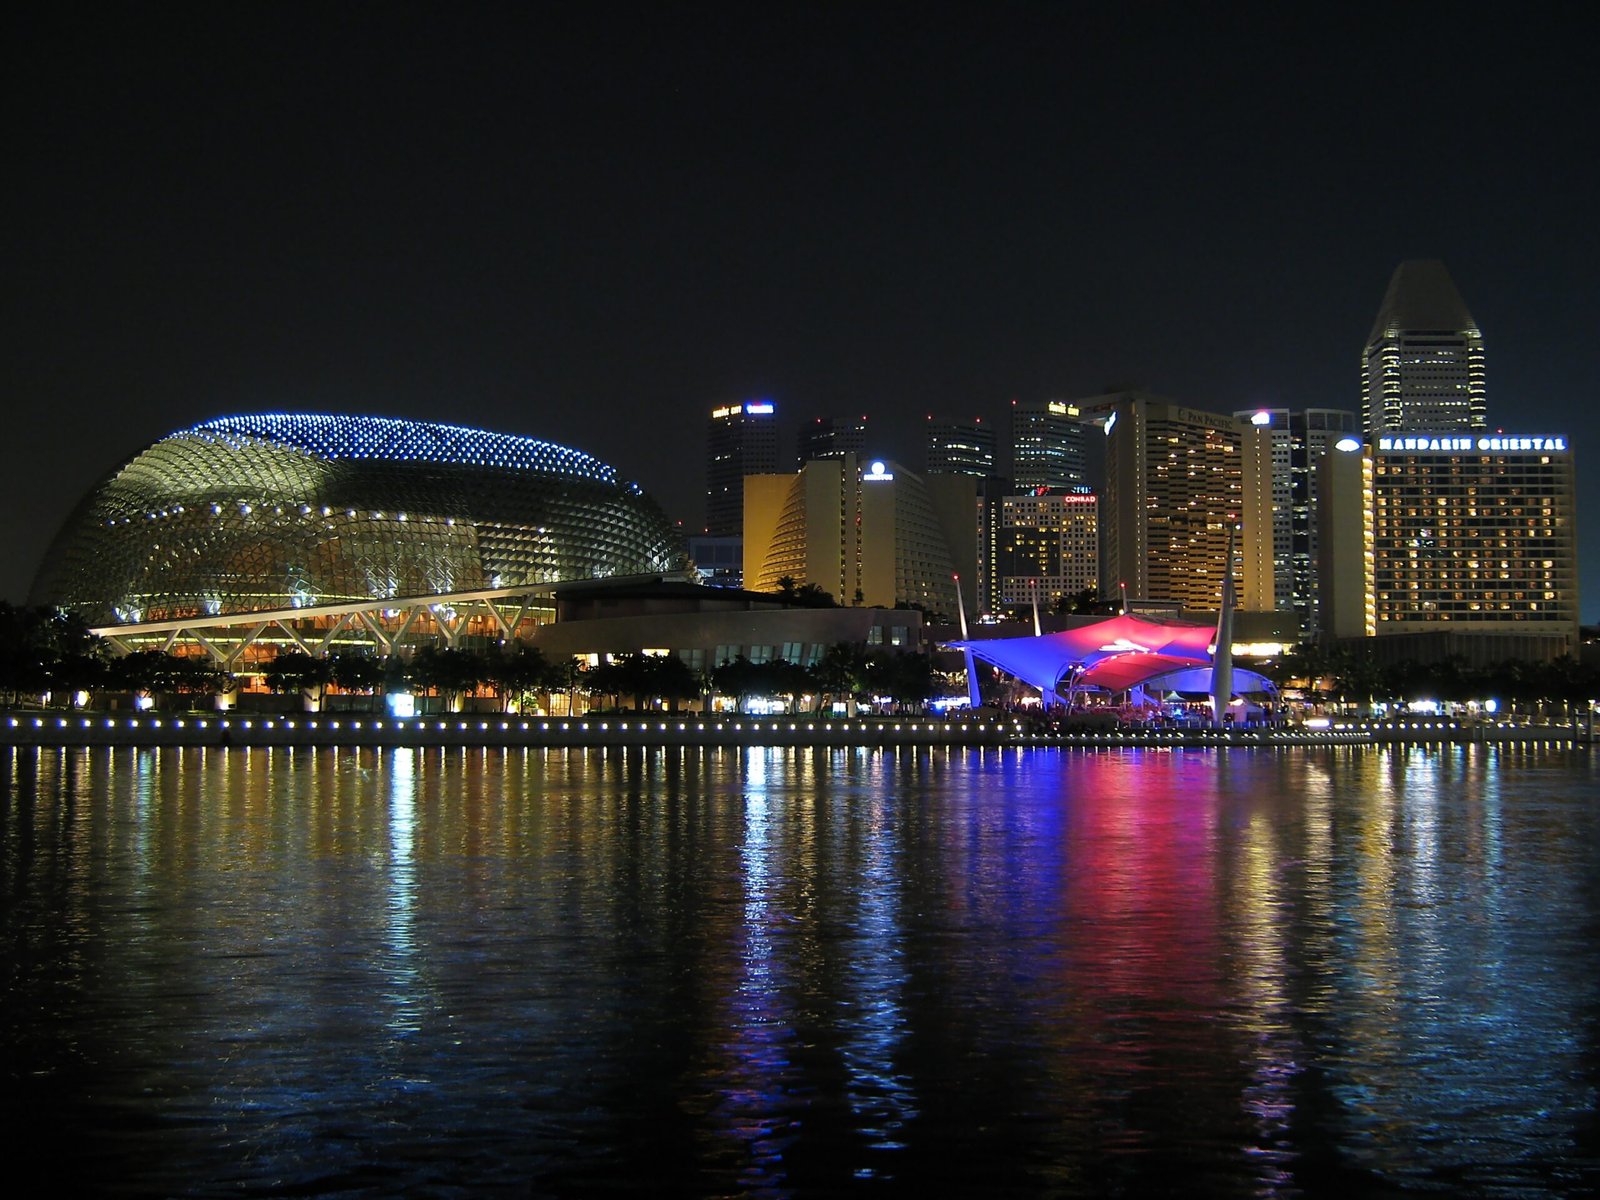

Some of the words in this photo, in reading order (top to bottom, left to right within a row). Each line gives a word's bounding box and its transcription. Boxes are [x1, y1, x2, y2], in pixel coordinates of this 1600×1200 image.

[1188, 411, 1204, 425] PAN
[1204, 413, 1233, 430] PACIFIC
[1379, 438, 1471, 450] MANDARIN
[1478, 438, 1565, 450] ORIENTAL
